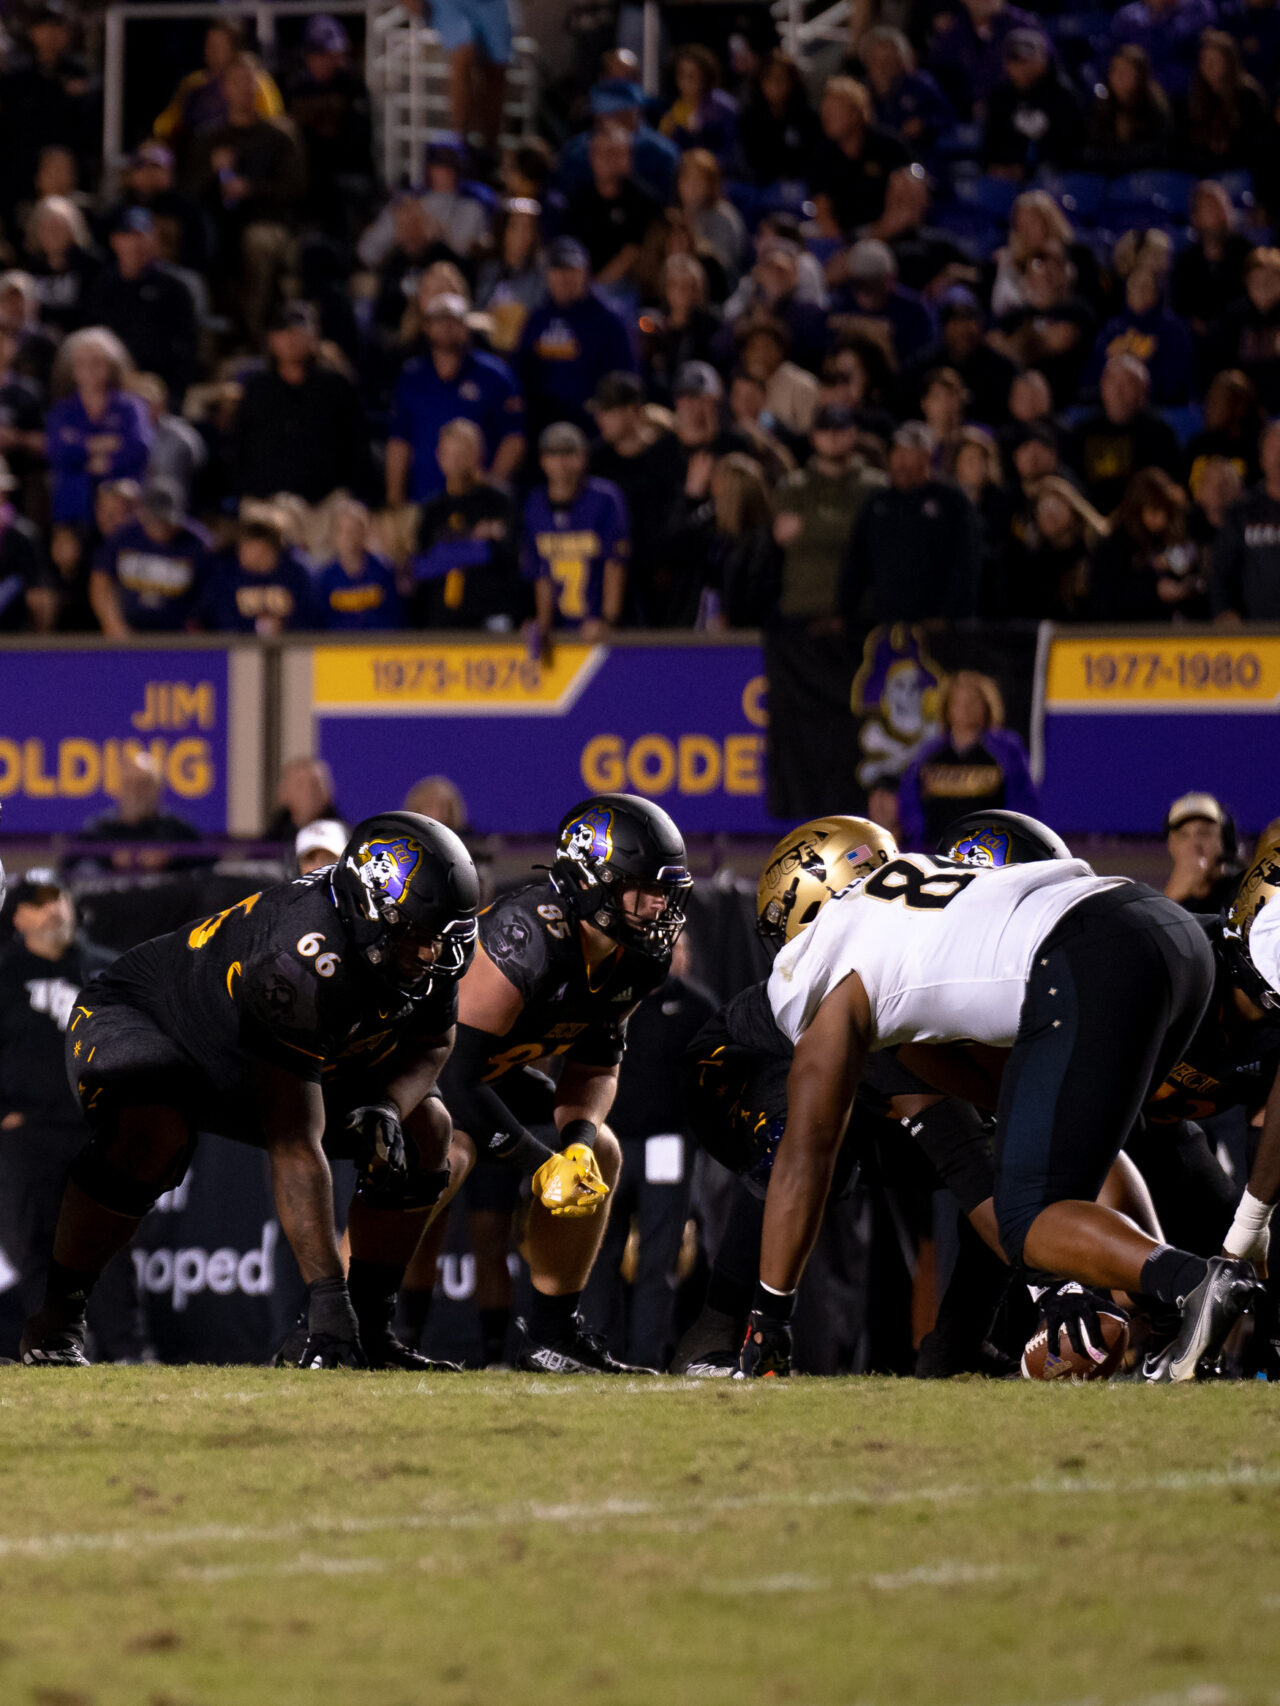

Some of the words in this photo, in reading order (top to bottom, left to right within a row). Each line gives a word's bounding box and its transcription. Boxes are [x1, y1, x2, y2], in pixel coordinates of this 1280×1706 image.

[1083, 653, 1261, 691] 1977-1980
[131, 681, 214, 731] JIM
[391, 843, 412, 865] ECU
[978, 832, 1004, 849] ECU
[536, 903, 573, 939] 85
[297, 931, 343, 978] 66
